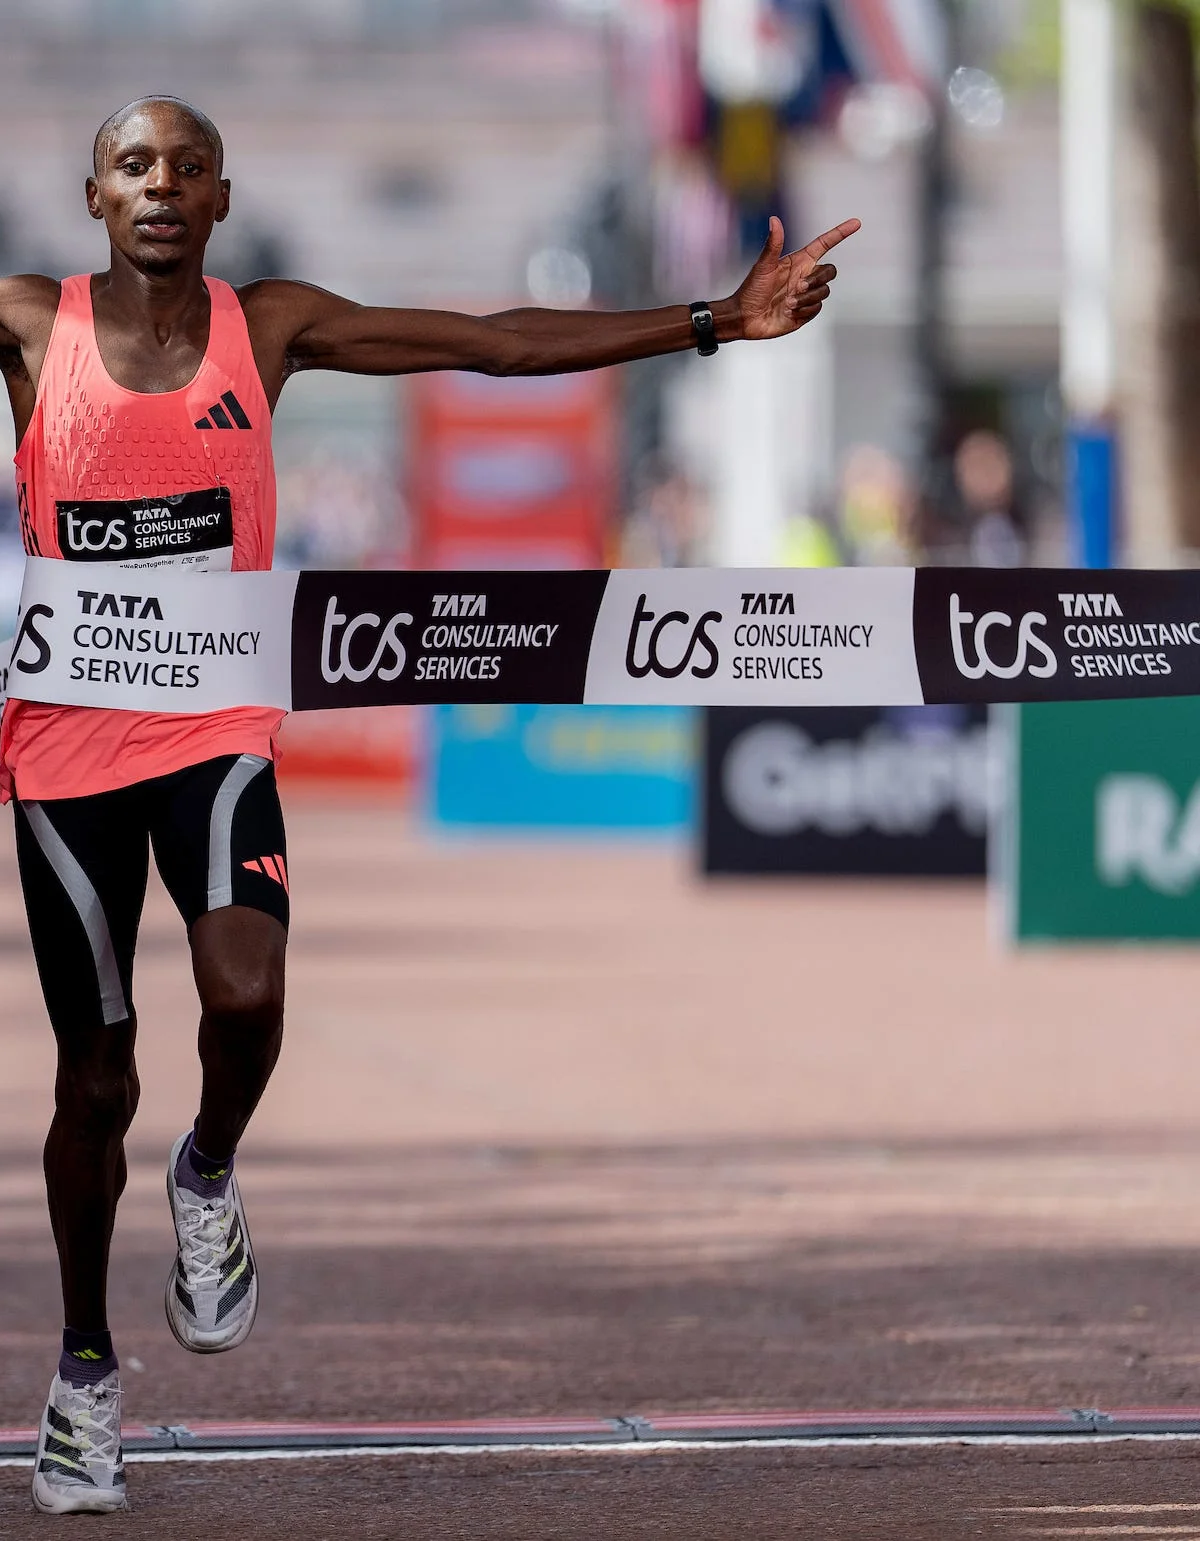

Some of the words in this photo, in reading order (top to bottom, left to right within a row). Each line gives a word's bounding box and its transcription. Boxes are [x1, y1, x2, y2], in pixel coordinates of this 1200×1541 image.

[133, 507, 171, 522] TATA
[134, 513, 220, 535] CONSULTANCY
[67, 512, 128, 551] tcs
[135, 531, 191, 549] SERVICES
[120, 559, 174, 570] WeRunTogether
[77, 590, 163, 620] TATA
[432, 595, 487, 617] TATA
[740, 593, 795, 614] TATA
[1057, 593, 1123, 617] TATA
[73, 624, 260, 655] CONSULTANCY
[321, 595, 413, 683] tcs
[421, 624, 559, 648] CONSULTANCY
[625, 593, 722, 678] tcs
[734, 625, 873, 647] CONSULTANCY
[950, 593, 1057, 679] tcs
[1063, 621, 1200, 648] CONSULTANC
[70, 656, 199, 688] SERVICES
[414, 656, 501, 680] SERVICES
[732, 657, 823, 679] SERVICES
[1070, 652, 1172, 678] SERVICES
